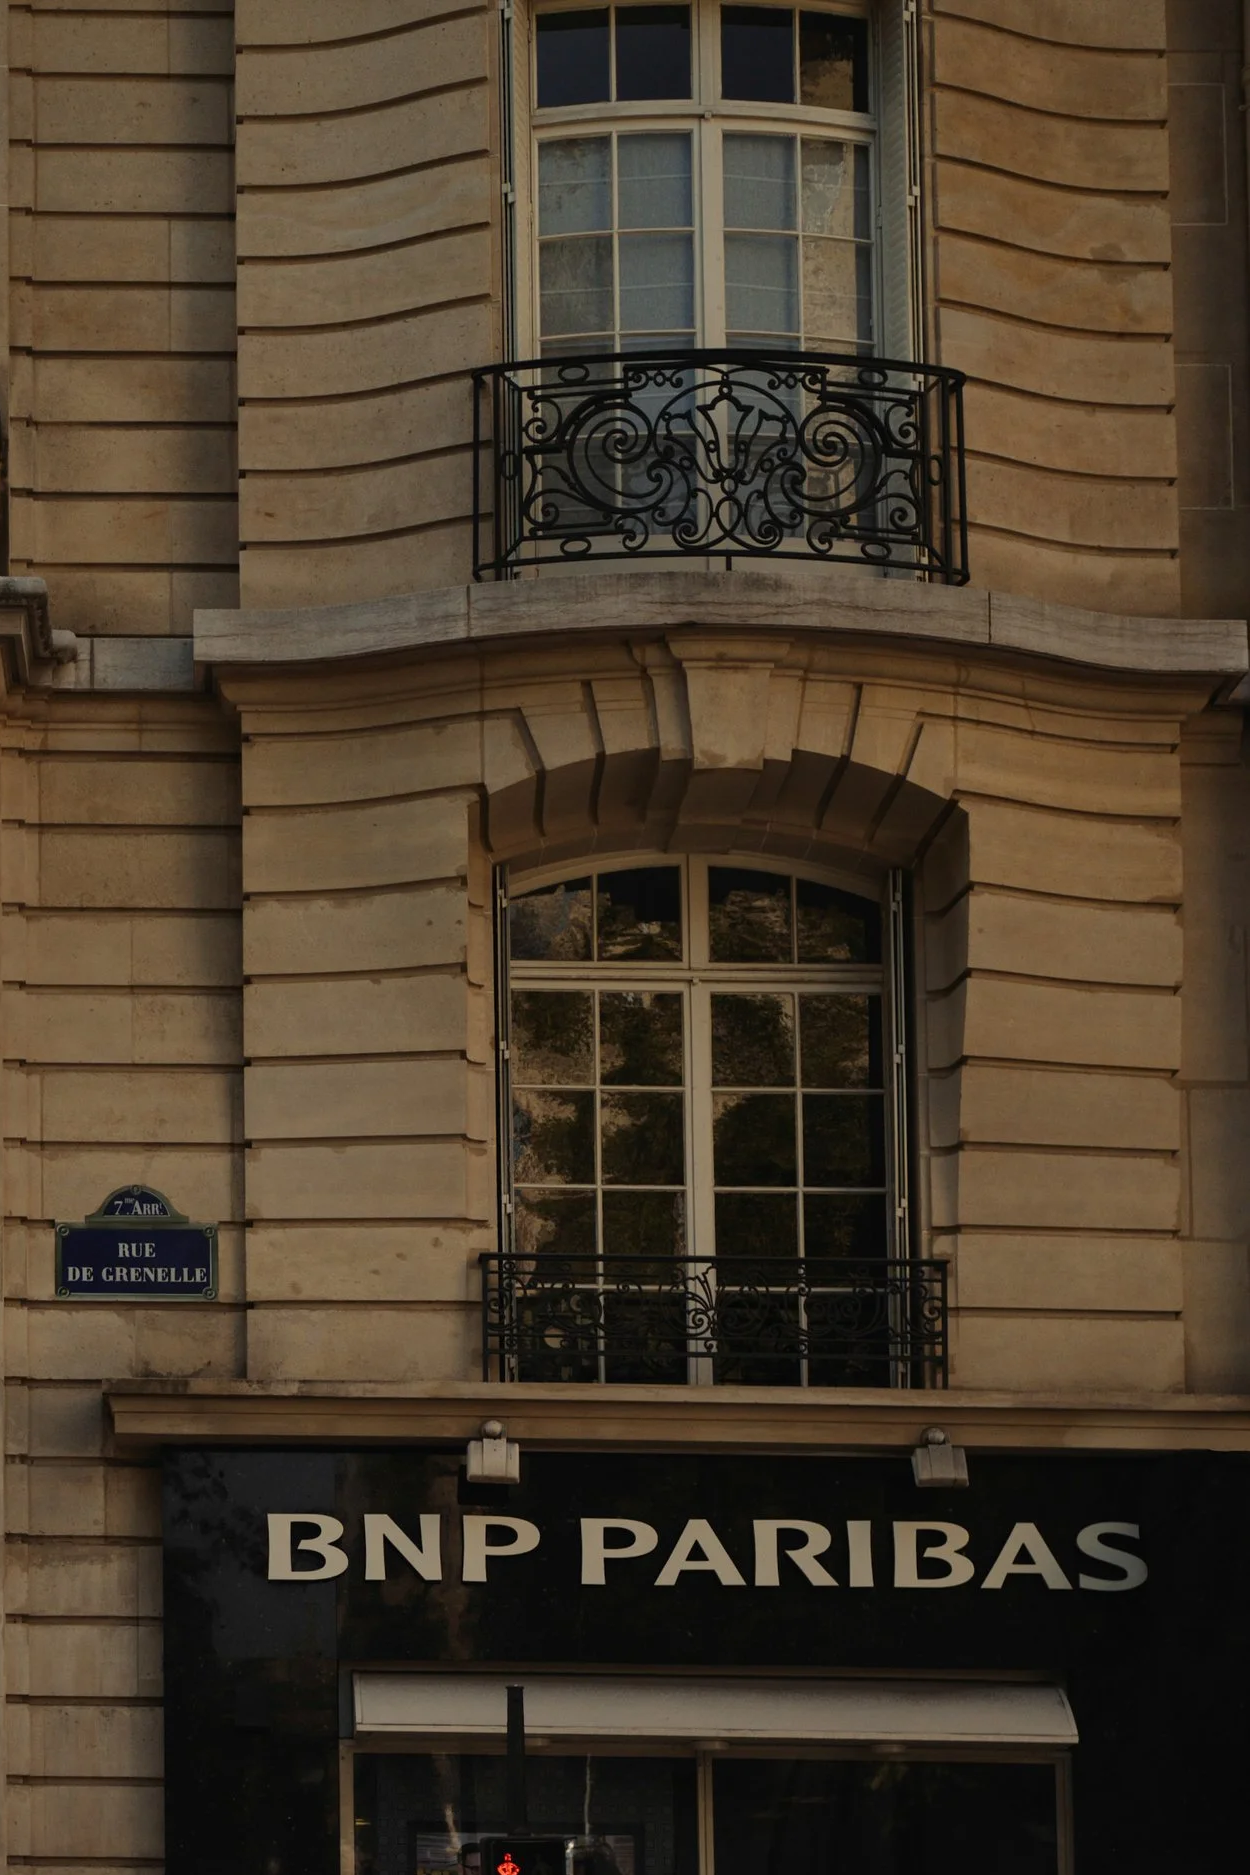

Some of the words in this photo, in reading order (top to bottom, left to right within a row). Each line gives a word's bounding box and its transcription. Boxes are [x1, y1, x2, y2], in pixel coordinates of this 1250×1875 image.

[117, 1242, 156, 1258] RUE
[67, 1266, 94, 1282] DE
[101, 1266, 208, 1283] GRENELLE
[266, 1511, 543, 1583] BNP
[579, 1517, 1150, 1592] PARIBAS
